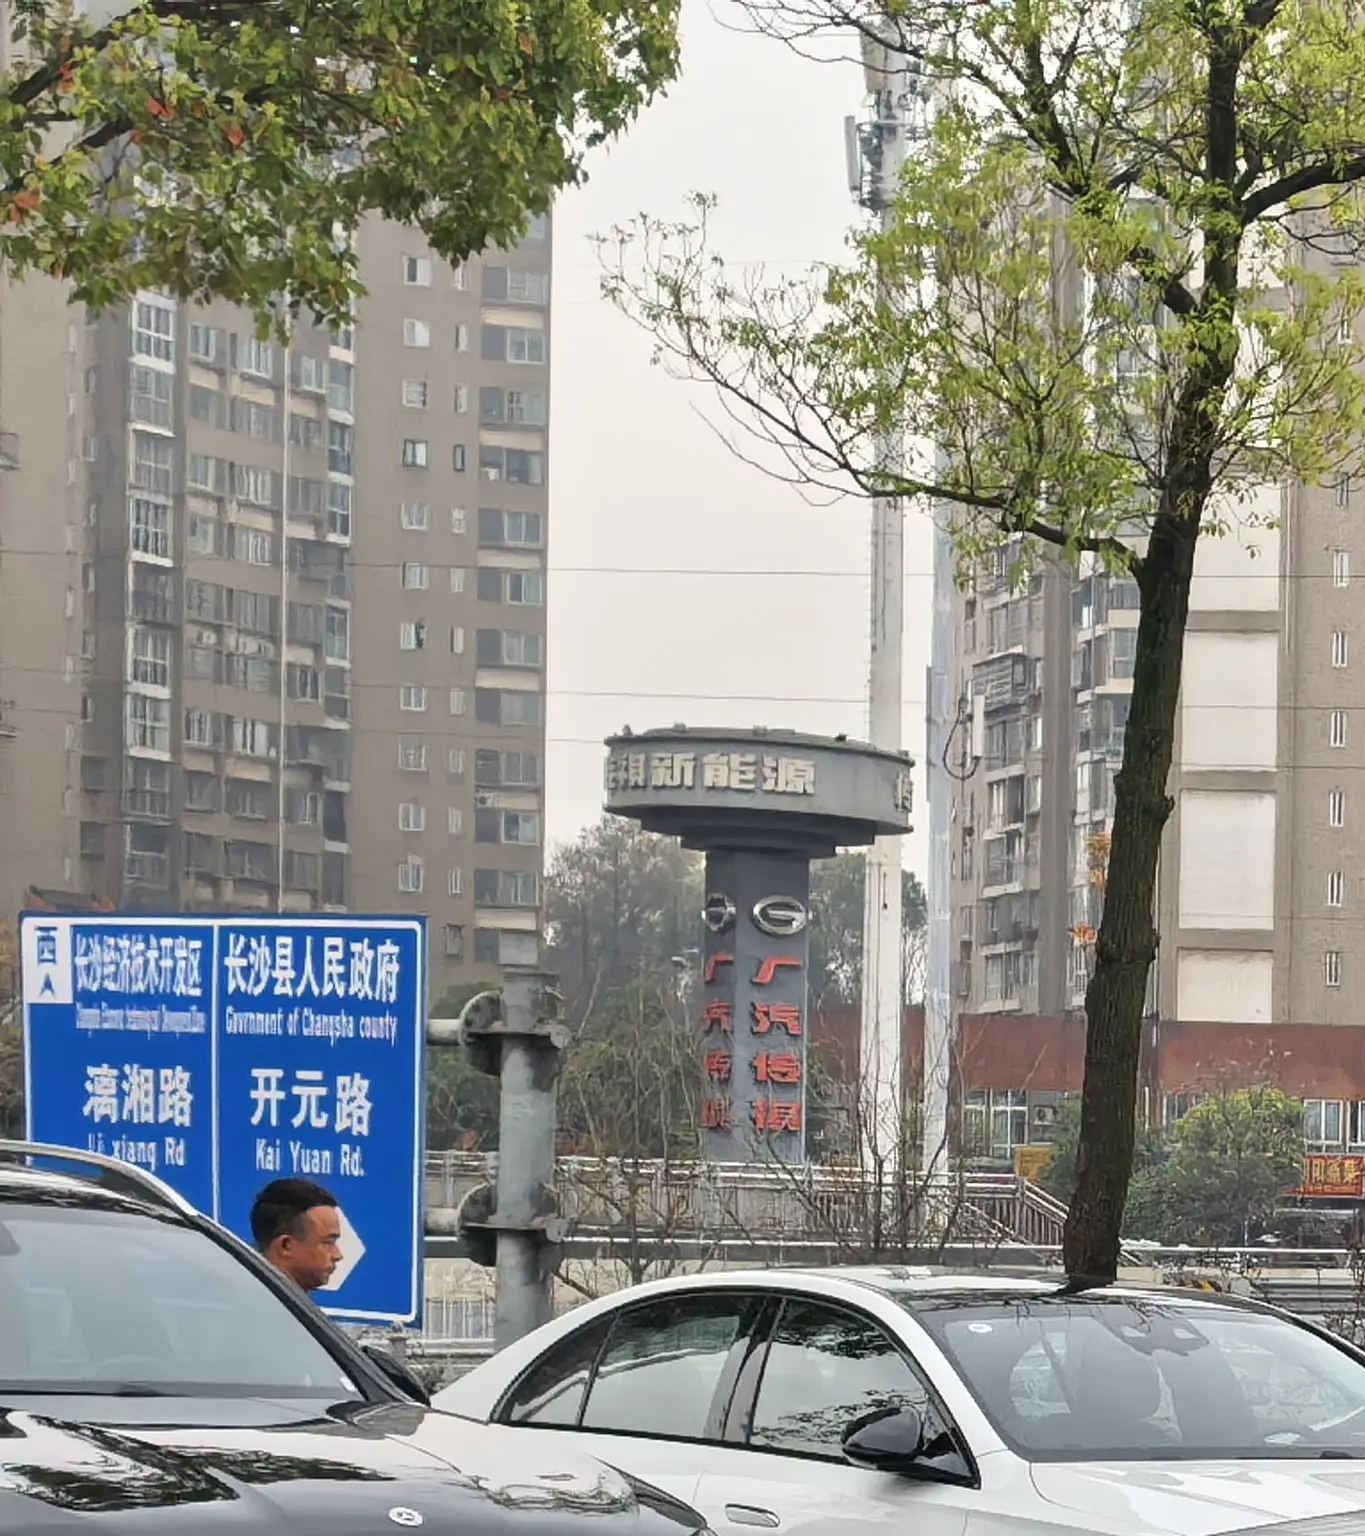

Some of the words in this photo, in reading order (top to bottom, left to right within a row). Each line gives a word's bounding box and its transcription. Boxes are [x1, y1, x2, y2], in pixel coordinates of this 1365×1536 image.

[223, 932, 401, 1004] 长沙县人民政府
[83, 1063, 194, 1127] 漓湘路
[250, 1069, 373, 1136] 开元路
[256, 1138, 281, 1172] Kai
[289, 1140, 332, 1175] Yuan
